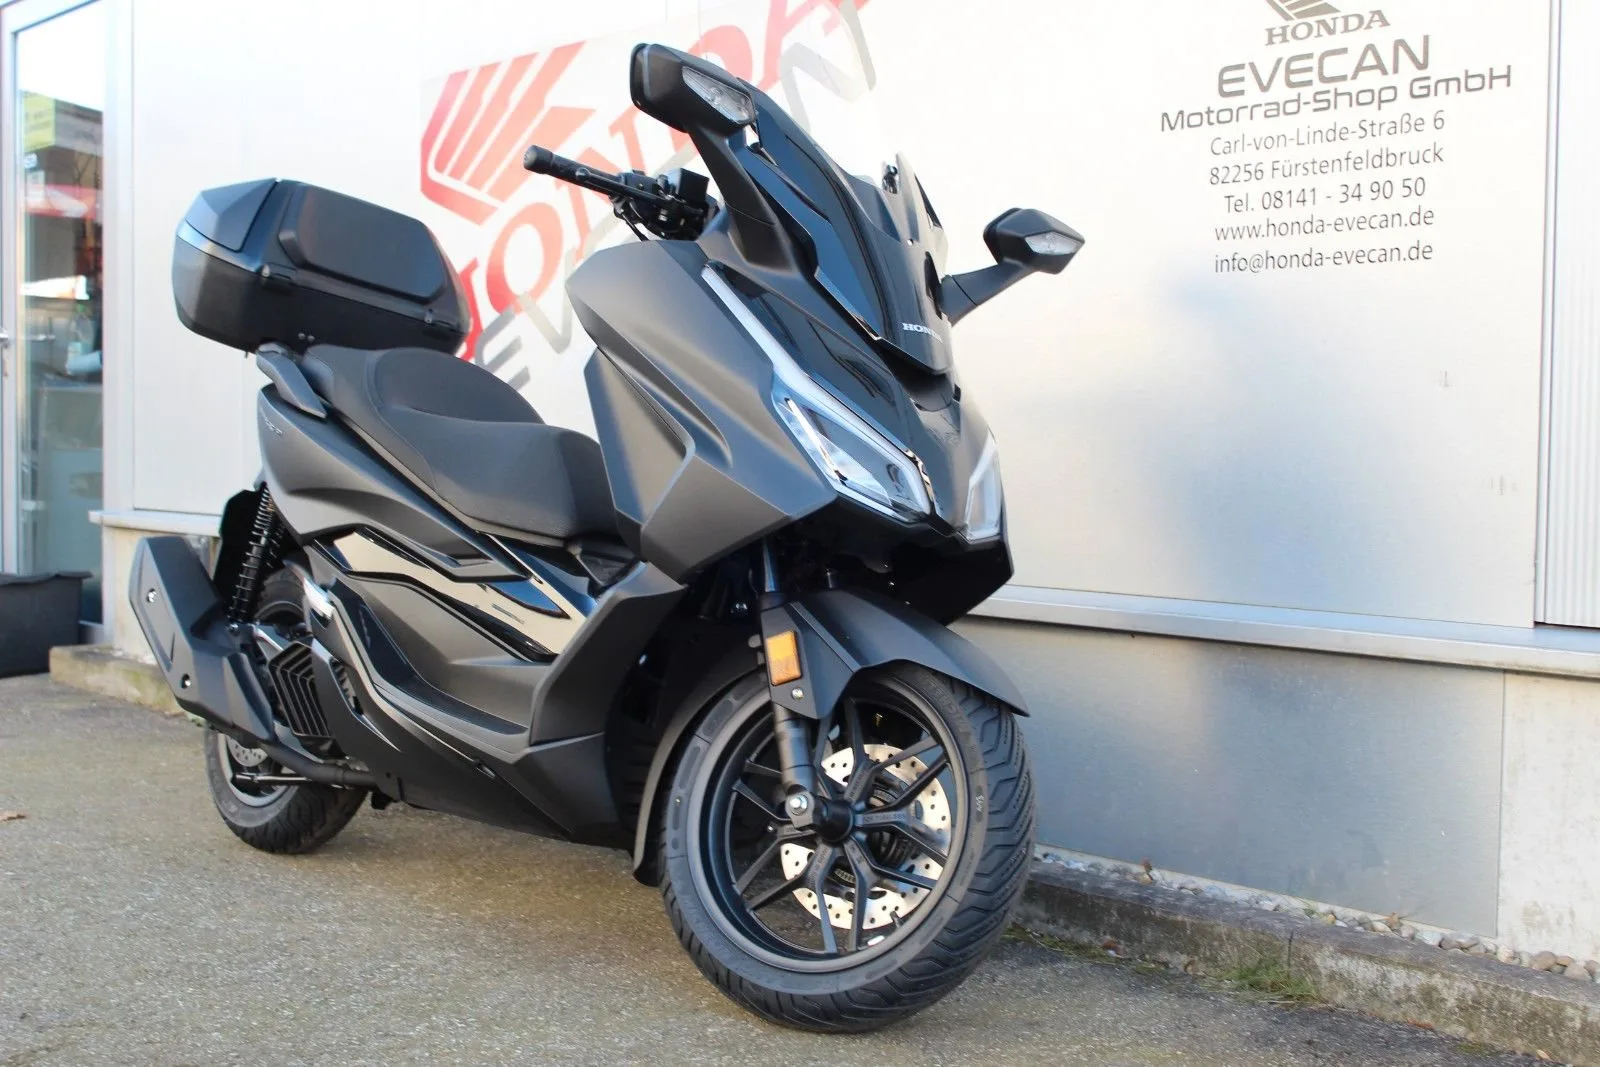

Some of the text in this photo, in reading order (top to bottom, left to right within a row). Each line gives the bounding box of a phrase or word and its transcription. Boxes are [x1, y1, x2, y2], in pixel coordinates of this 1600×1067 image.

[1265, 9, 1391, 46] HONDA
[1217, 34, 1431, 98] EVECAN
[1160, 64, 1512, 132] Motorrad-Shop GmbH
[1210, 110, 1446, 156] Carl-von-Linde-Straße 6
[1209, 142, 1445, 186] 82256 Fürstenfeldbruck
[1224, 192, 1255, 214] Tel.
[1261, 187, 1317, 211] 08141
[1338, 183, 1363, 204] 34
[1370, 180, 1394, 201] 90
[1402, 176, 1426, 197] 50
[1214, 205, 1435, 241] www.honda-evecan.de
[1214, 240, 1434, 273] info@honda-evecan.de
[902, 322, 943, 344] HON
